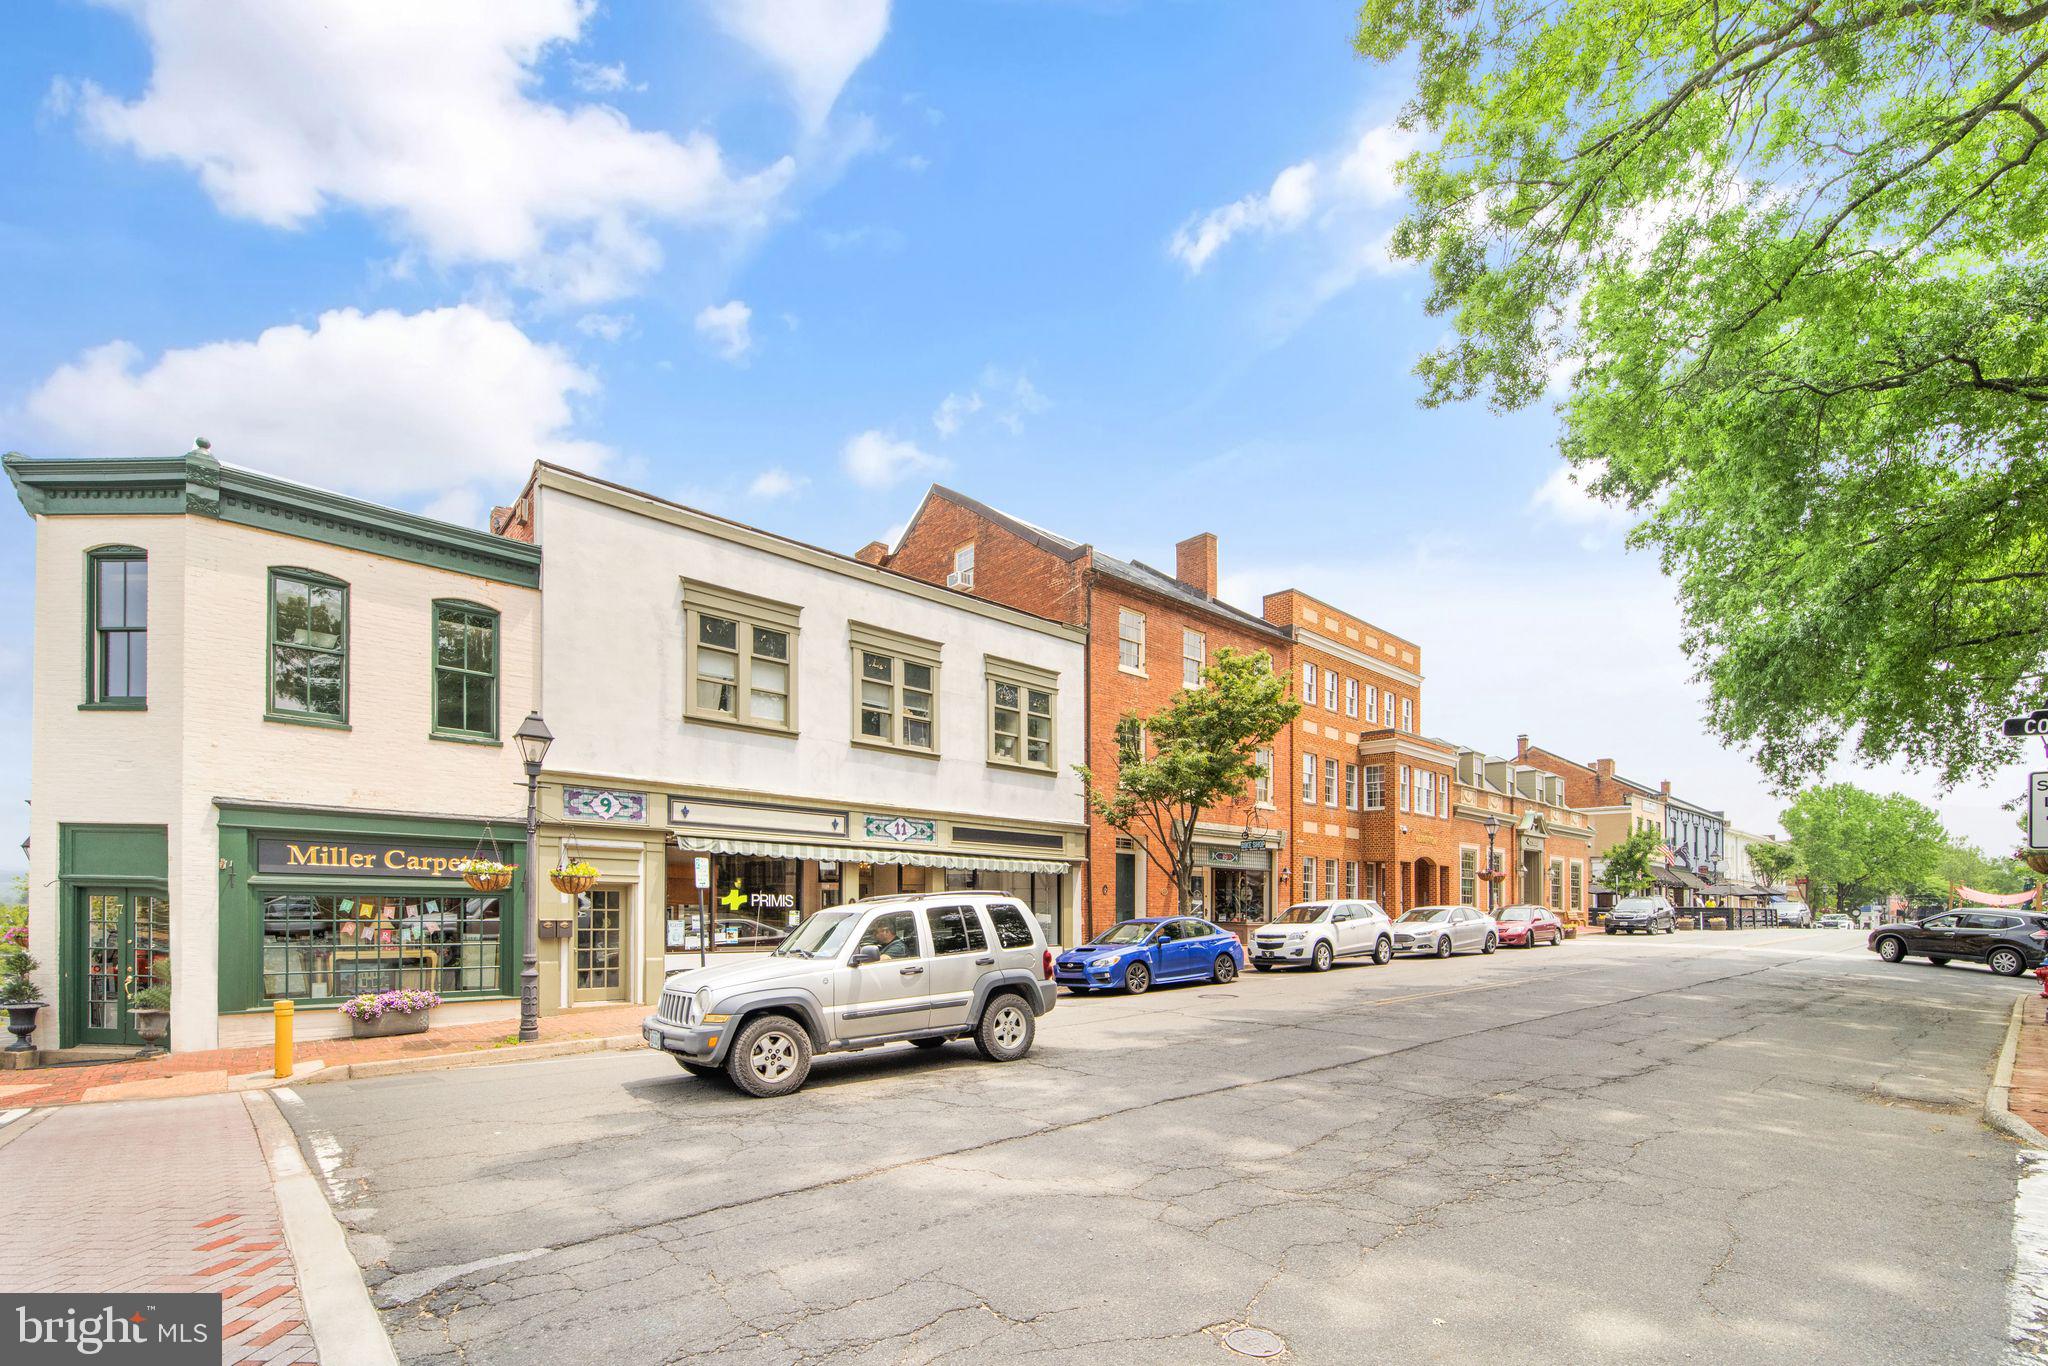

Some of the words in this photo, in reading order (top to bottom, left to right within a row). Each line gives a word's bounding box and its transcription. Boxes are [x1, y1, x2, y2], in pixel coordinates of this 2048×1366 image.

[2024, 719, 2048, 734] CO
[600, 797, 611, 813] 9
[895, 822, 906, 835] 11
[1253, 840, 1265, 848] SHOP
[286, 844, 377, 868] Miller
[384, 850, 478, 876] Carpet
[751, 893, 794, 908] PRIMIS
[116, 904, 123, 914] 7
